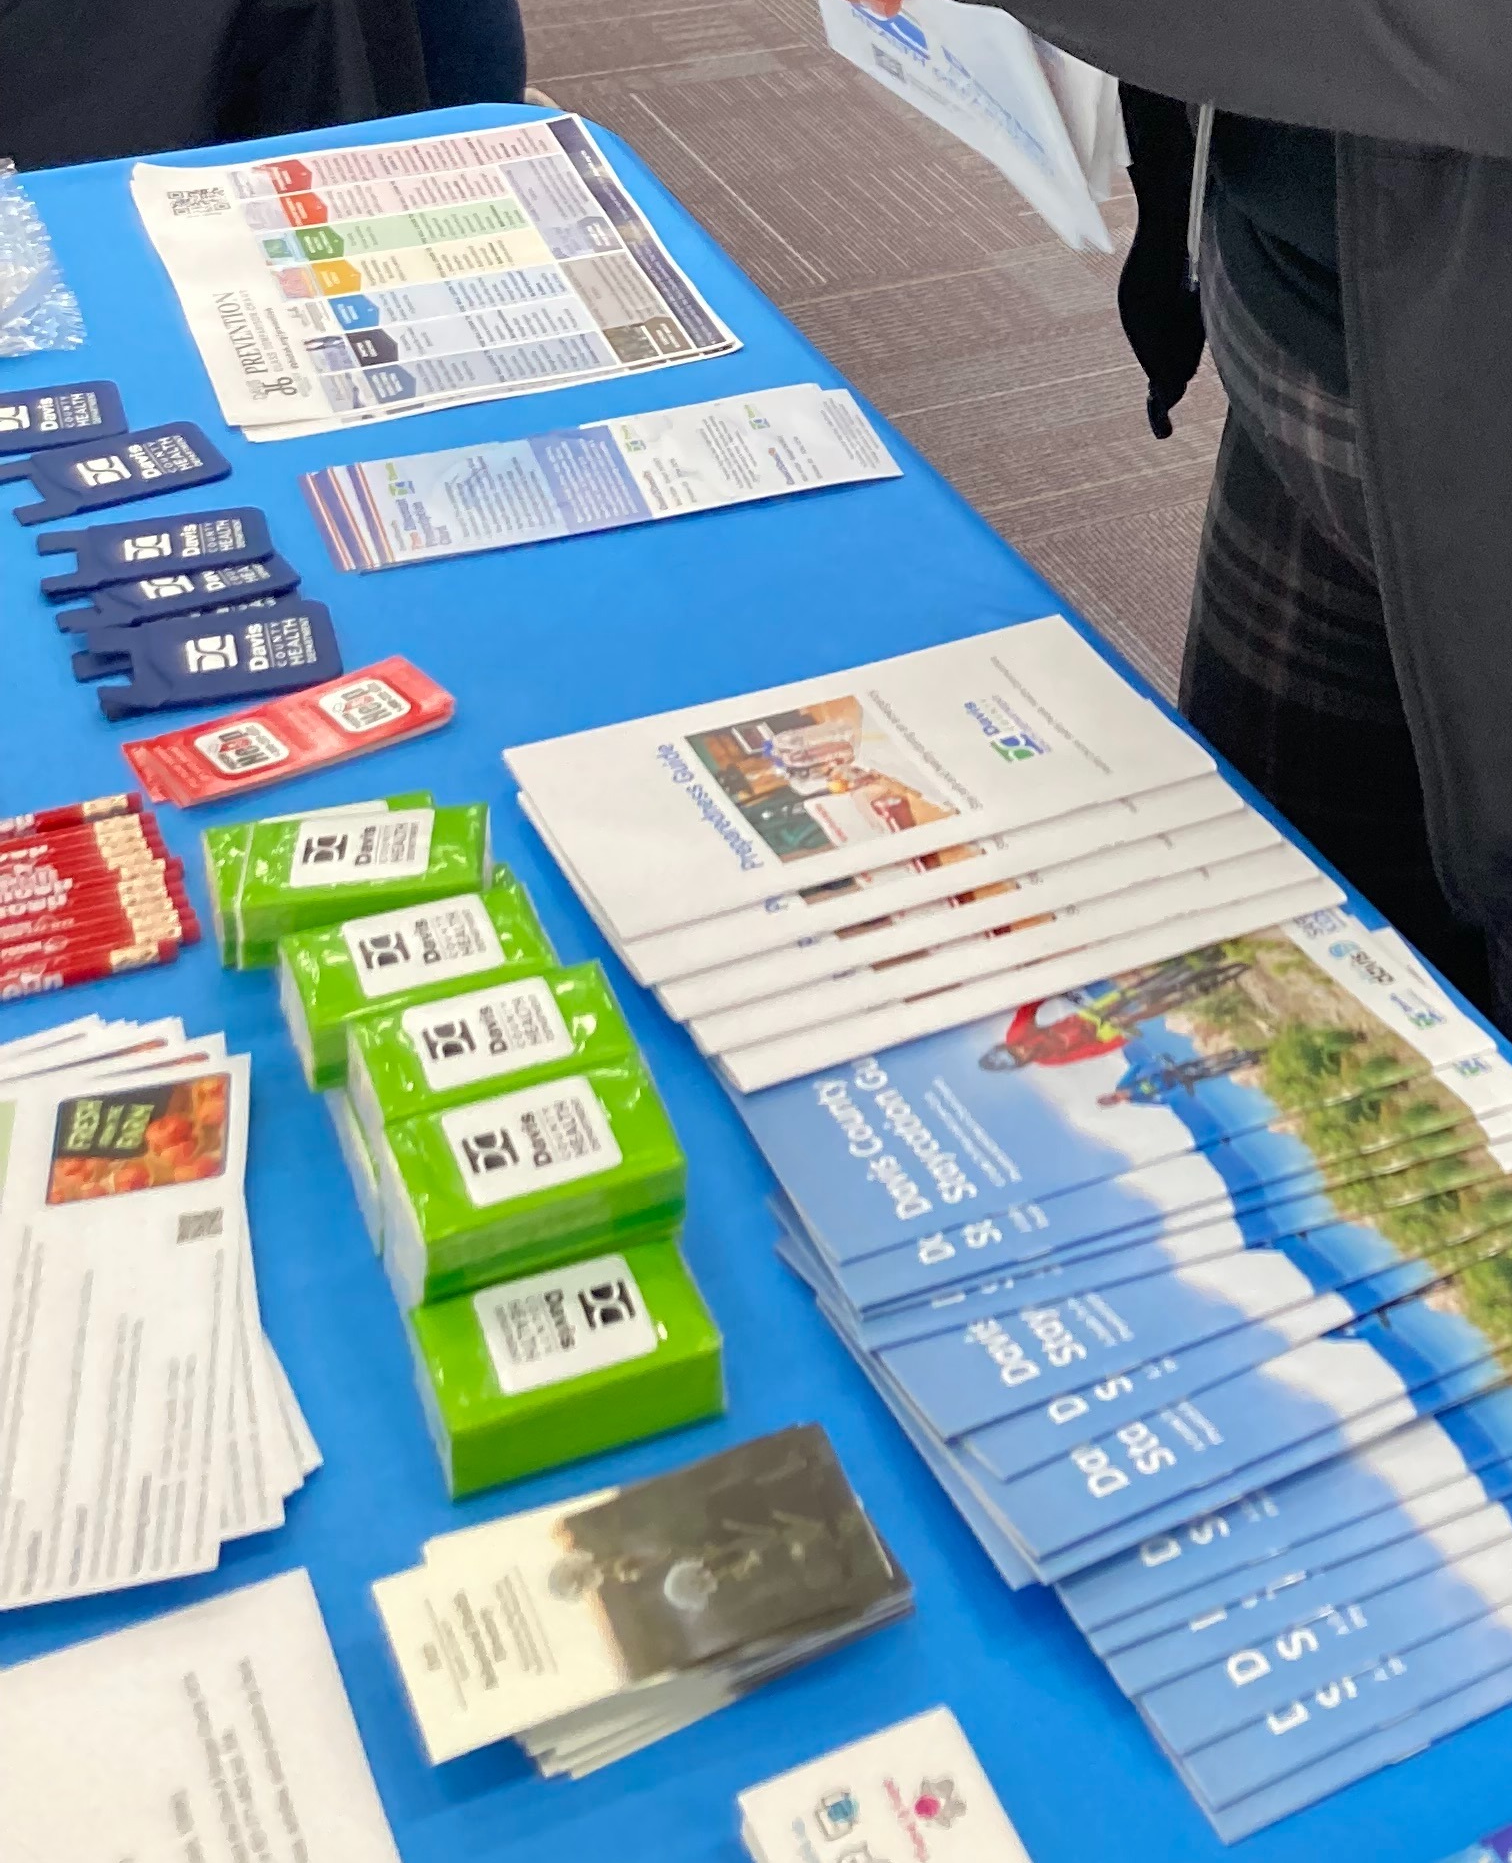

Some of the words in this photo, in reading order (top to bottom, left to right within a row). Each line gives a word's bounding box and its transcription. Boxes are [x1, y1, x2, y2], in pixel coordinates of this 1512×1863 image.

[213, 292, 268, 374] PREVENTION
[37, 397, 58, 432] Davis
[71, 393, 89, 427] HEALTH
[128, 444, 162, 479] Davis
[158, 437, 192, 471] HEALTH
[180, 524, 200, 557] Davis
[216, 520, 234, 551] HEALTH
[246, 624, 269, 671] Davis
[270, 622, 287, 667] COUNTY
[282, 618, 304, 665] HEALTH
[656, 742, 695, 784] Guide
[355, 826, 376, 866] Davis
[414, 918, 441, 964] Davis
[479, 1006, 507, 1055] Davis
[521, 1112, 553, 1167] Davis
[813, 1079, 884, 1157] County
[875, 1087, 978, 1203] Staycation
[868, 1154, 933, 1220] Davis
